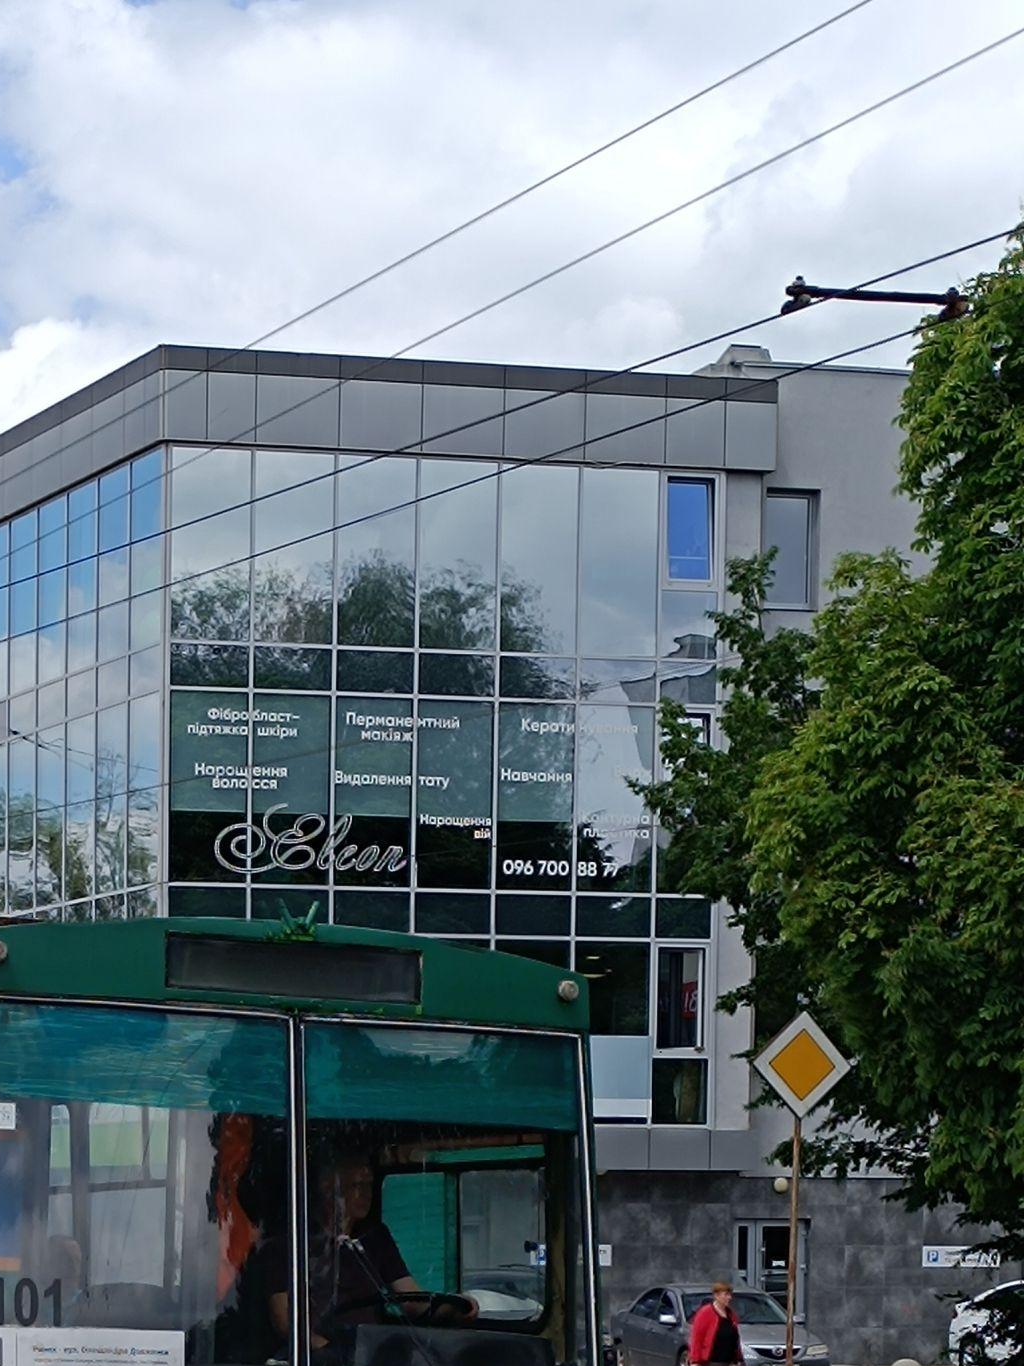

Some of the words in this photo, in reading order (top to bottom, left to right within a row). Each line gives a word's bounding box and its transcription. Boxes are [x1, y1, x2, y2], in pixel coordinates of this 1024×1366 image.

[345, 711, 460, 729] Перманентний
[187, 722, 248, 737] підтяжка
[257, 724, 298, 739] шкіри
[360, 728, 414, 742] макіяж
[212, 778, 278, 789] волосся
[335, 770, 411, 787] Видалення
[419, 775, 450, 790] тату
[500, 769, 573, 783] Навчання
[419, 813, 492, 828] Нарощення
[502, 859, 535, 876] 096
[538, 859, 570, 876] 700
[577, 861, 598, 877] 88
